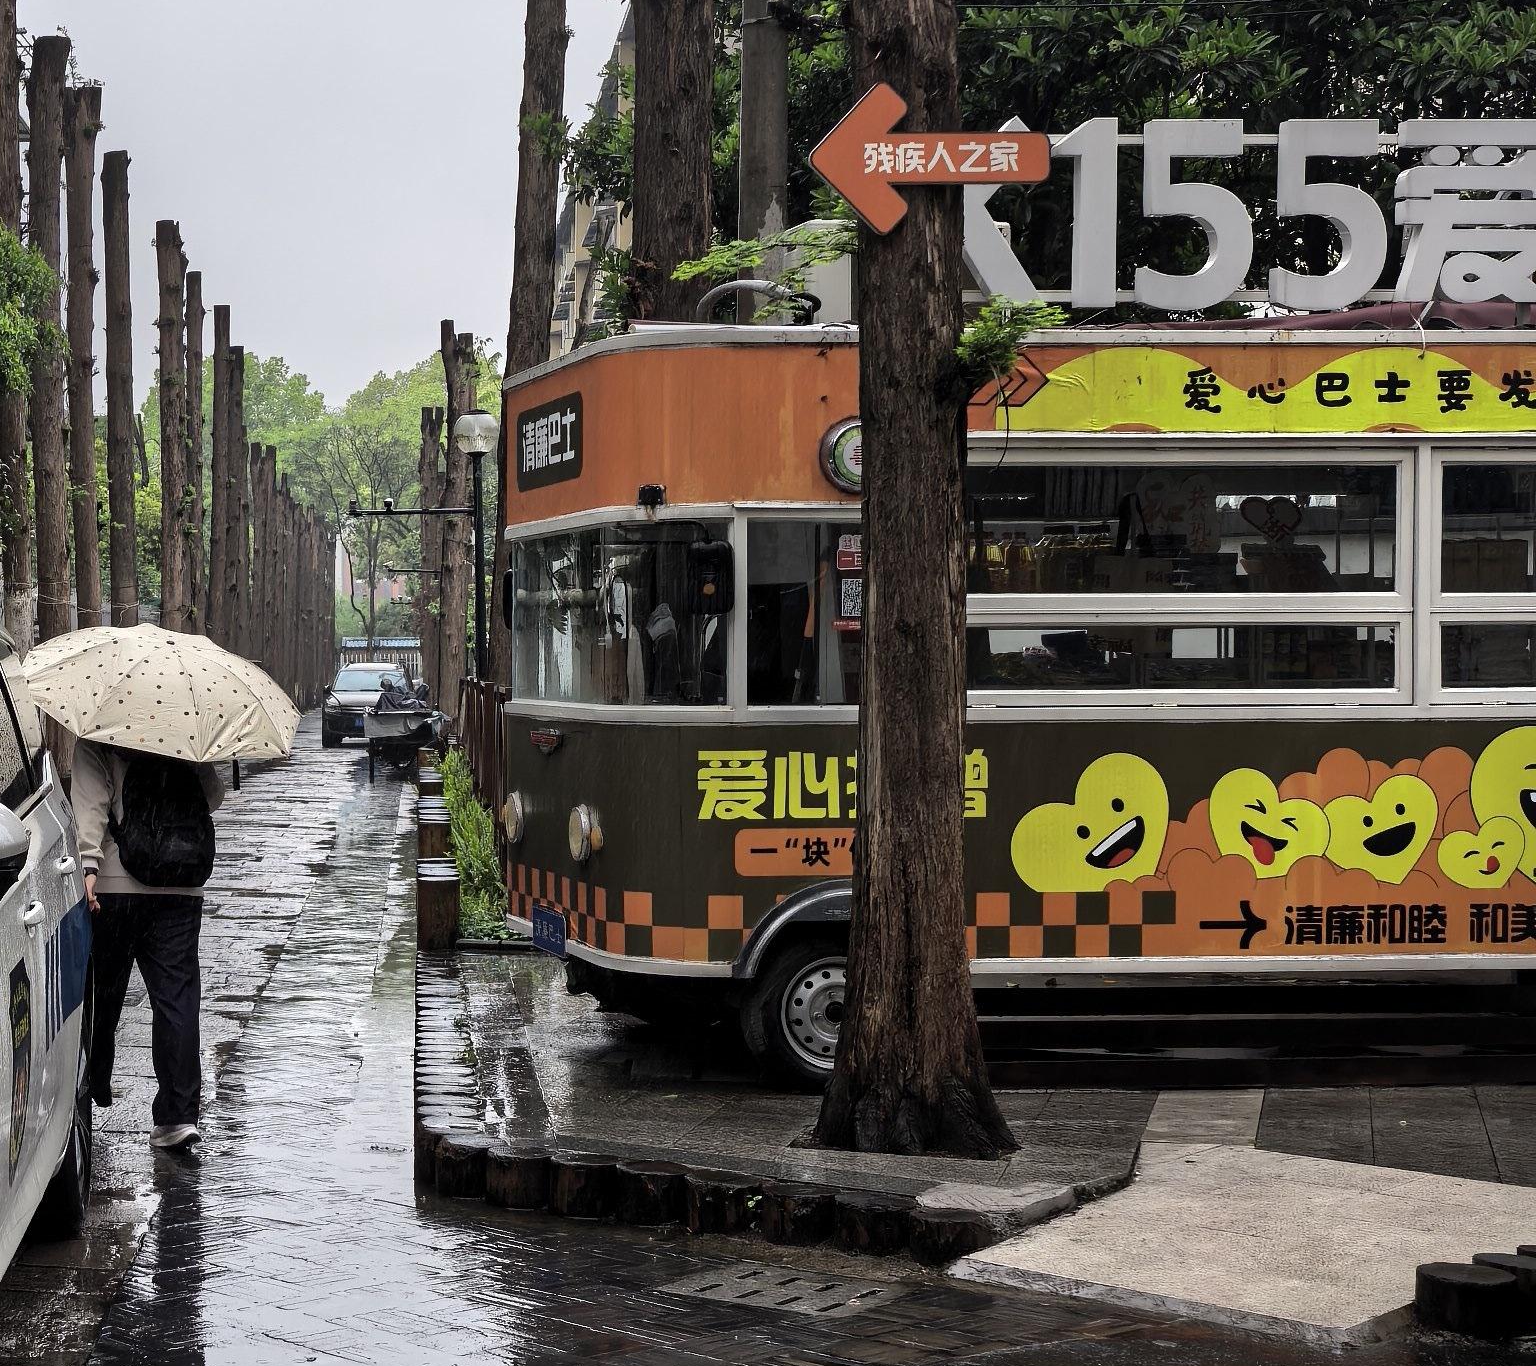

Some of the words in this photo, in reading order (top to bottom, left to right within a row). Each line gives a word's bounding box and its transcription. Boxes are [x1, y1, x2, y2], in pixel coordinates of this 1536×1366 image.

[864, 140, 1019, 174] 残疾人之家
[522, 407, 576, 473] 清廉巴士
[1284, 903, 1447, 945] 清廉和睦
